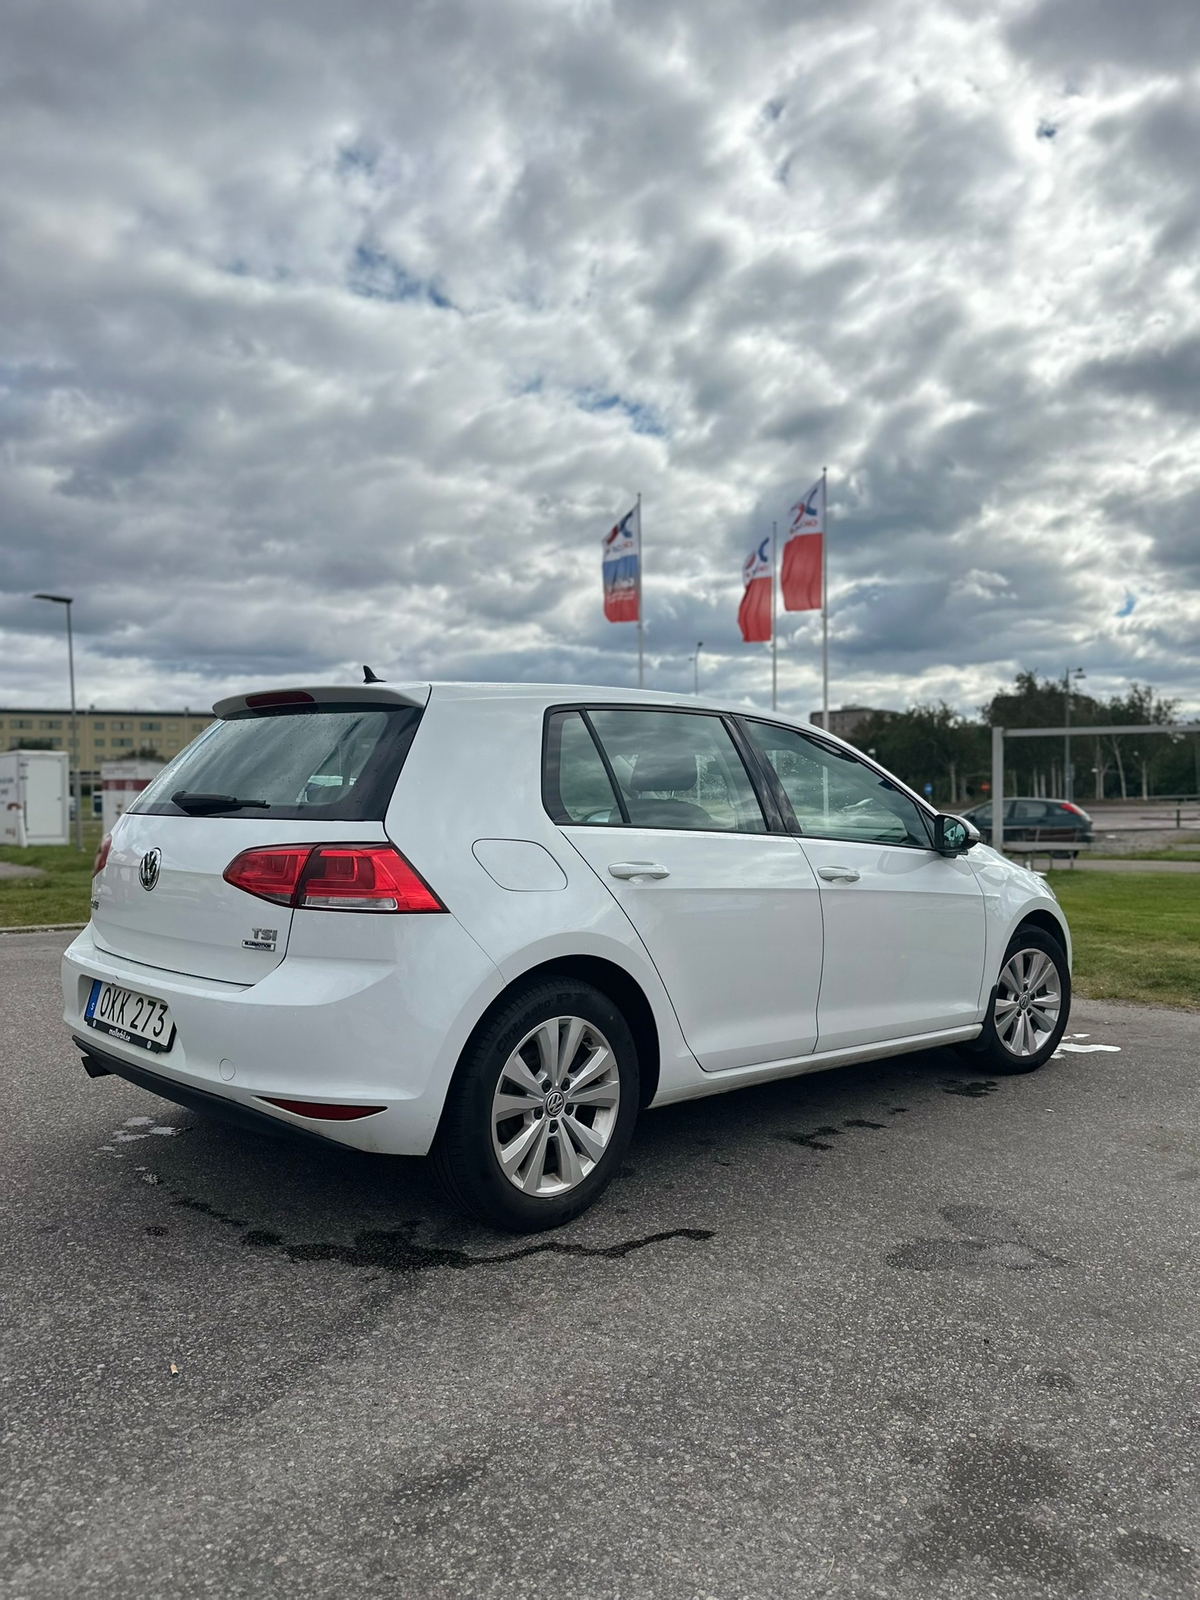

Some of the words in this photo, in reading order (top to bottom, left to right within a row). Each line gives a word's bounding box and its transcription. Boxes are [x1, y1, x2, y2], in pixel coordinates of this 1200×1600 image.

[251, 928, 277, 941] TSI
[100, 987, 131, 1025] OKK
[130, 997, 169, 1037] 273
[496, 1000, 550, 1054] Cinturato
